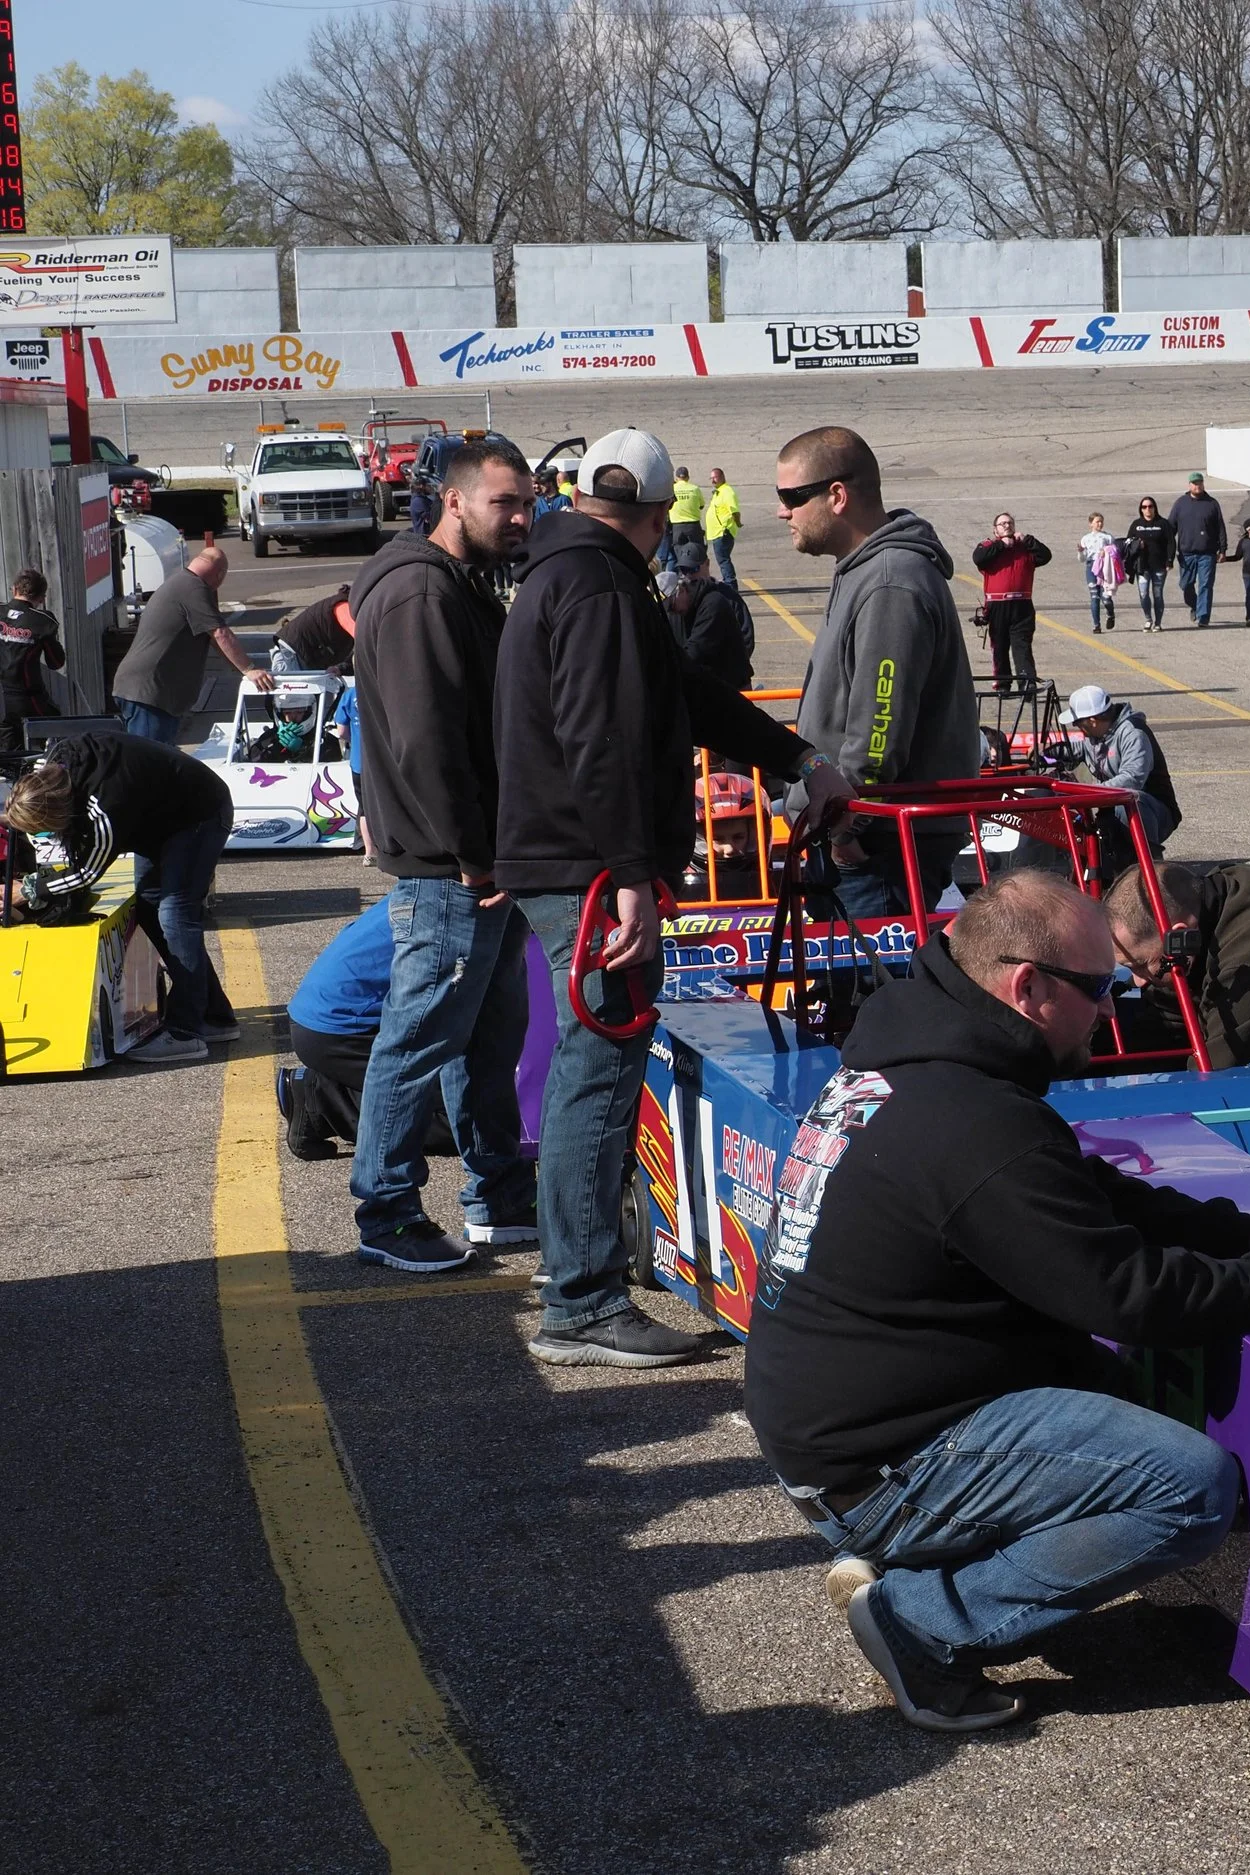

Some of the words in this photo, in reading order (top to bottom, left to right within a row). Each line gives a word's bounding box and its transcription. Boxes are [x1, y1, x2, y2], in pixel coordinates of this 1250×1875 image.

[2, 83, 15, 104] 6
[4, 114, 17, 134] 9
[2, 207, 23, 229] 16
[35, 253, 128, 266] Ridderman
[135, 250, 159, 262] Oil
[48, 275, 79, 284] Your
[85, 273, 141, 283] Success
[17, 290, 79, 306] Dragon
[1163, 316, 1219, 331] CUSTOM
[565, 331, 611, 339] TRAILER
[613, 329, 650, 338] SALES
[765, 322, 920, 364] TUSTINS
[1017, 318, 1075, 354] Team
[1075, 316, 1151, 354] Spirit
[1160, 334, 1225, 350] TRAILERS
[13, 343, 43, 354] Jeep
[439, 331, 555, 379] Techworks
[161, 342, 255, 389] Sunny
[263, 334, 341, 389] Bay
[521, 365, 545, 373] INC.
[562, 355, 656, 369] 574-294-7200
[822, 356, 857, 367] ASPHALT
[858, 355, 892, 365] SEALING
[207, 377, 303, 392] DISPOSAL
[663, 939, 739, 968] ime
[723, 1124, 776, 1200] RE/MAX
[732, 1182, 753, 1222] ELITE
[656, 1235, 677, 1270] KLOTZ
